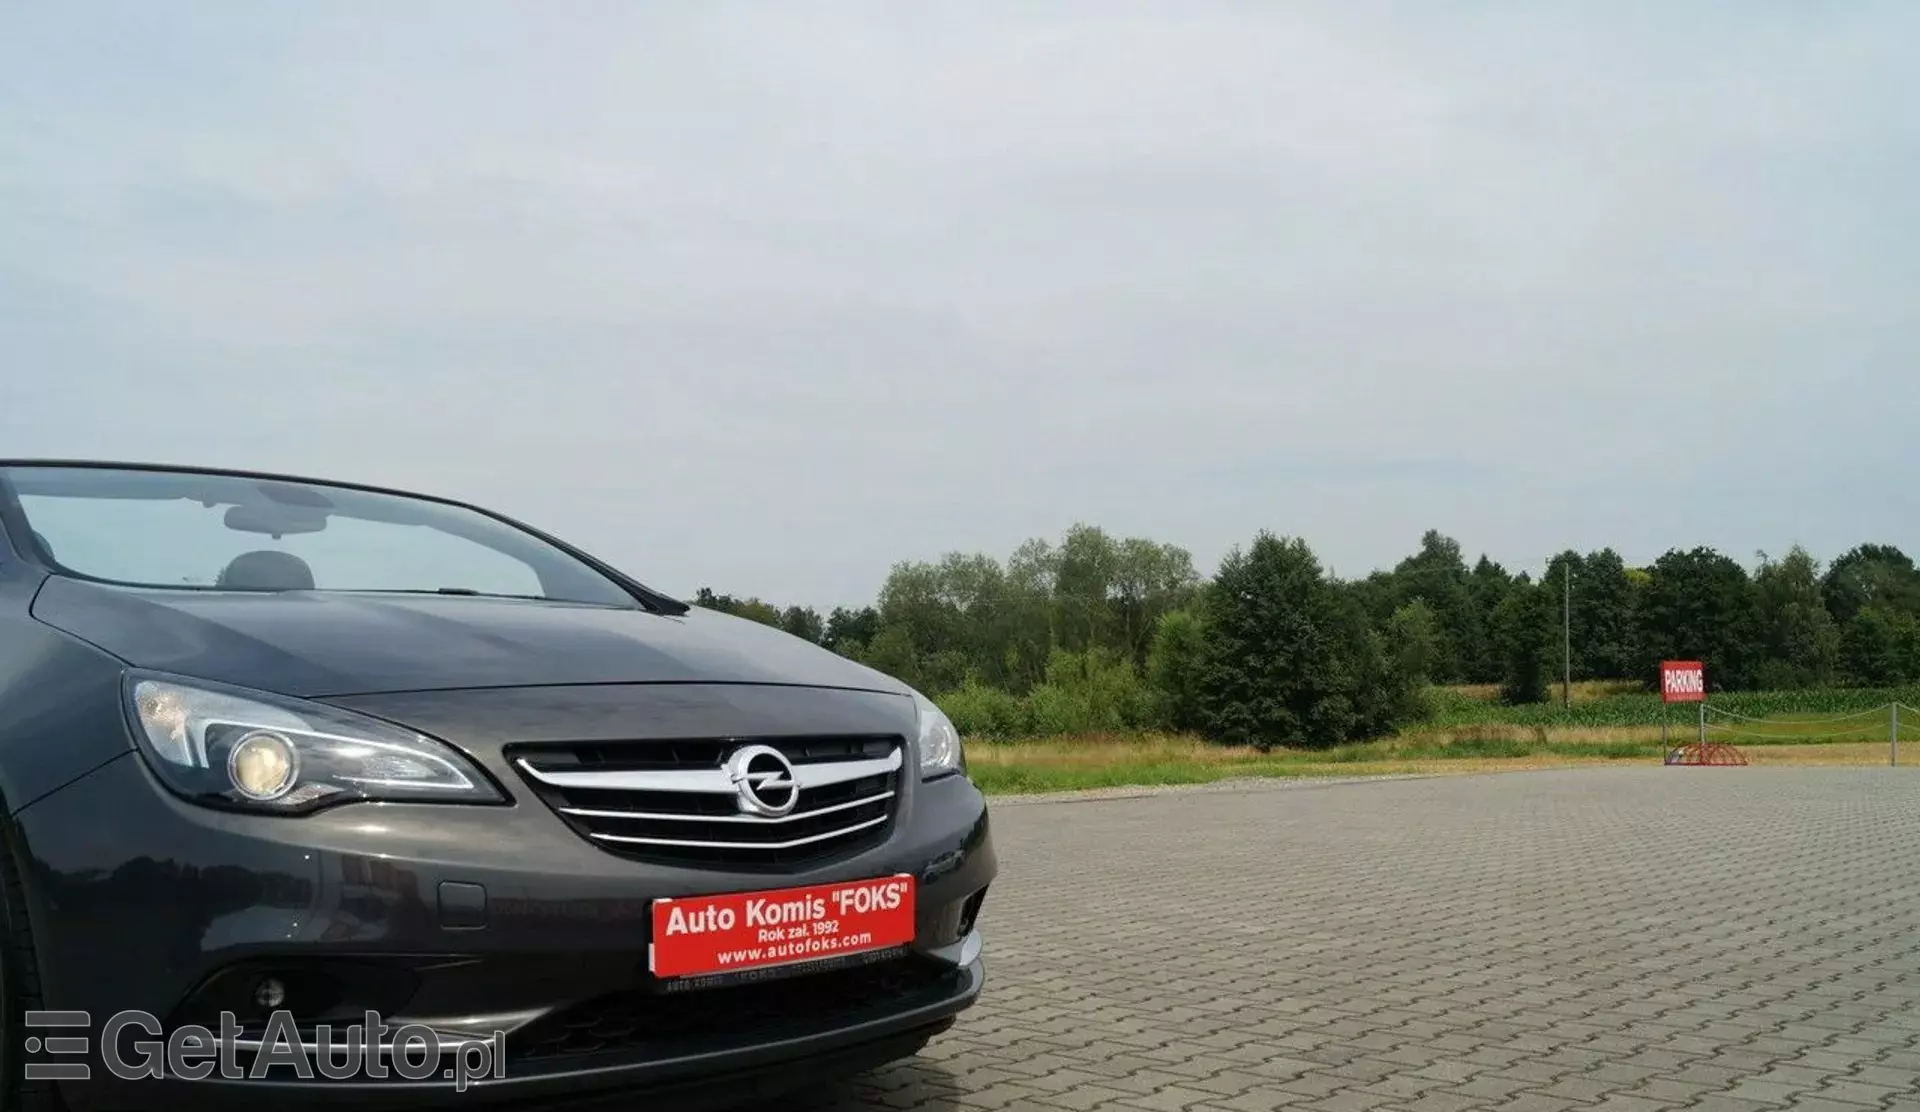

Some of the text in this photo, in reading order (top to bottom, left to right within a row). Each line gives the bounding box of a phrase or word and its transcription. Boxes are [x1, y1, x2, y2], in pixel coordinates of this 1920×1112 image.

[1664, 669, 1704, 693] PARKING
[665, 882, 908, 936] Auto Komis "FOKS"
[758, 927, 785, 943] Rok
[812, 920, 840, 935] 1992
[717, 932, 872, 964] www.autofoks.com
